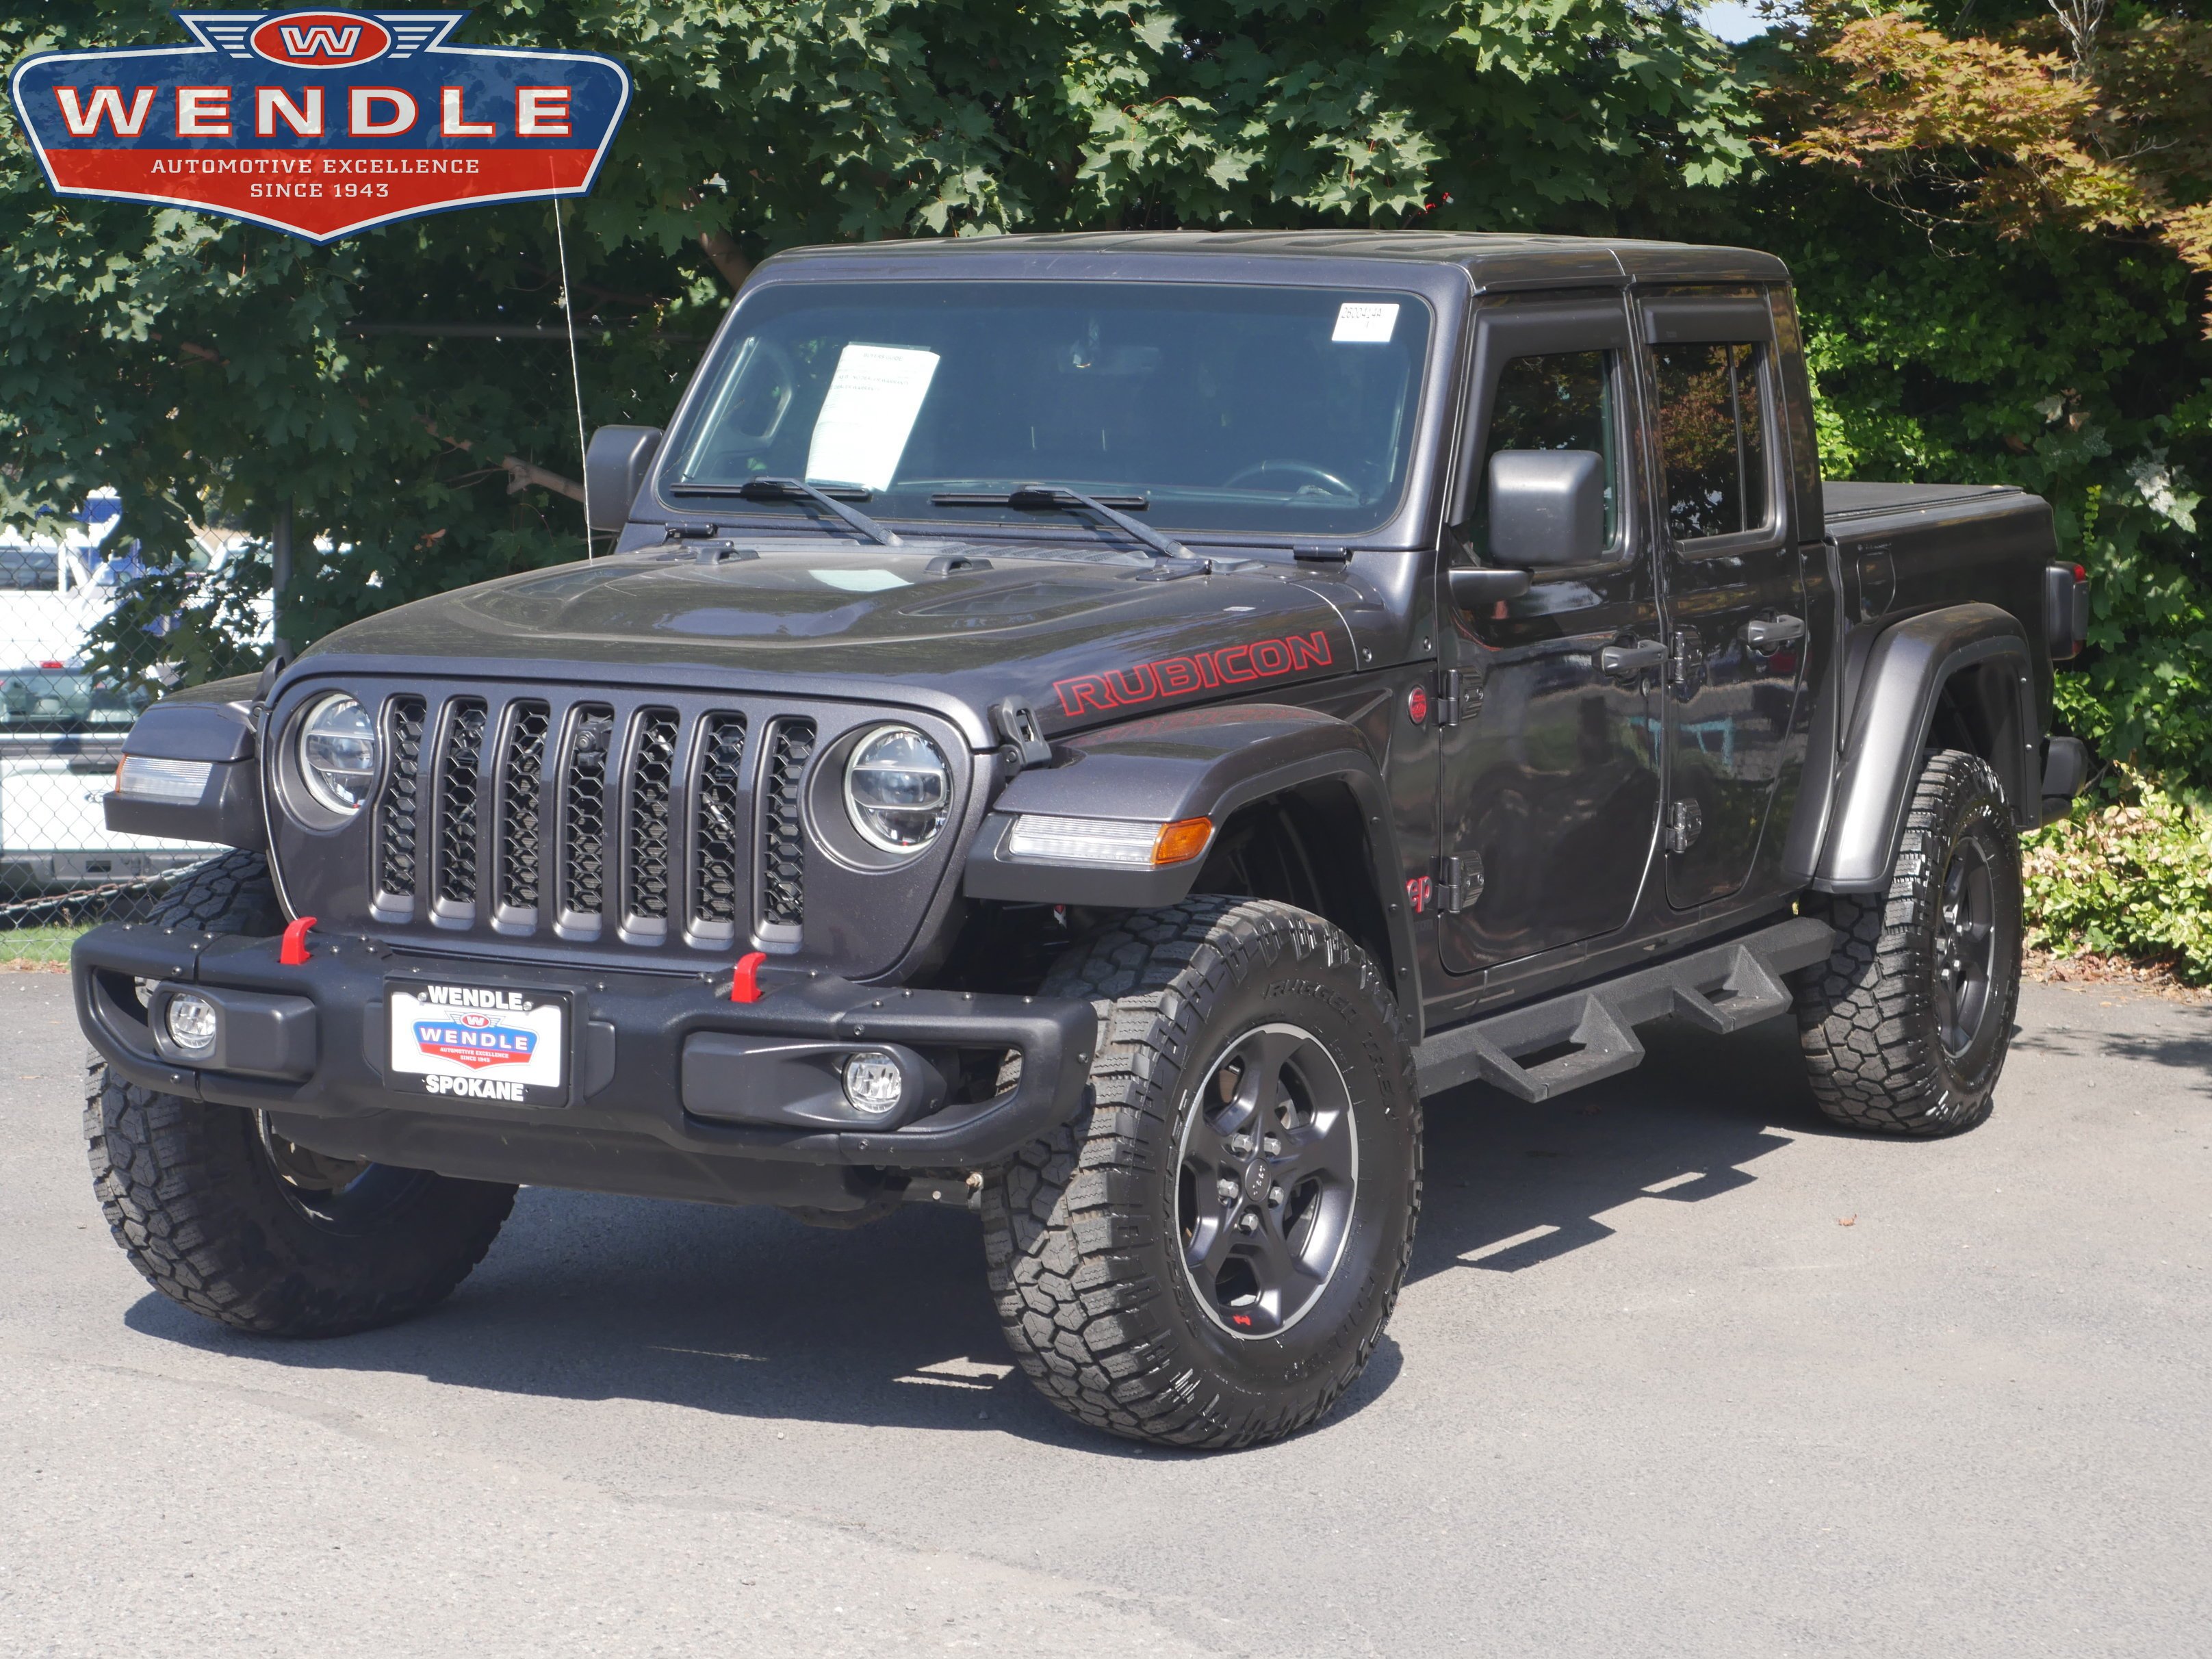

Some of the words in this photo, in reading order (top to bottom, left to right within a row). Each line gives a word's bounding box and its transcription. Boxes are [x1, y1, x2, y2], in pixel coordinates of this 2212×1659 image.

[1053, 630, 1333, 717] RUBICON
[1406, 875, 1432, 914] ep
[427, 985, 523, 1011] WENDLE
[1263, 978, 1361, 1025] RUGGED
[420, 1027, 528, 1051] WENDLE
[440, 1047, 474, 1055] AUTOMOTIVE
[475, 1050, 509, 1059] EXCELLENCE
[426, 1075, 524, 1102] SPOKANE
